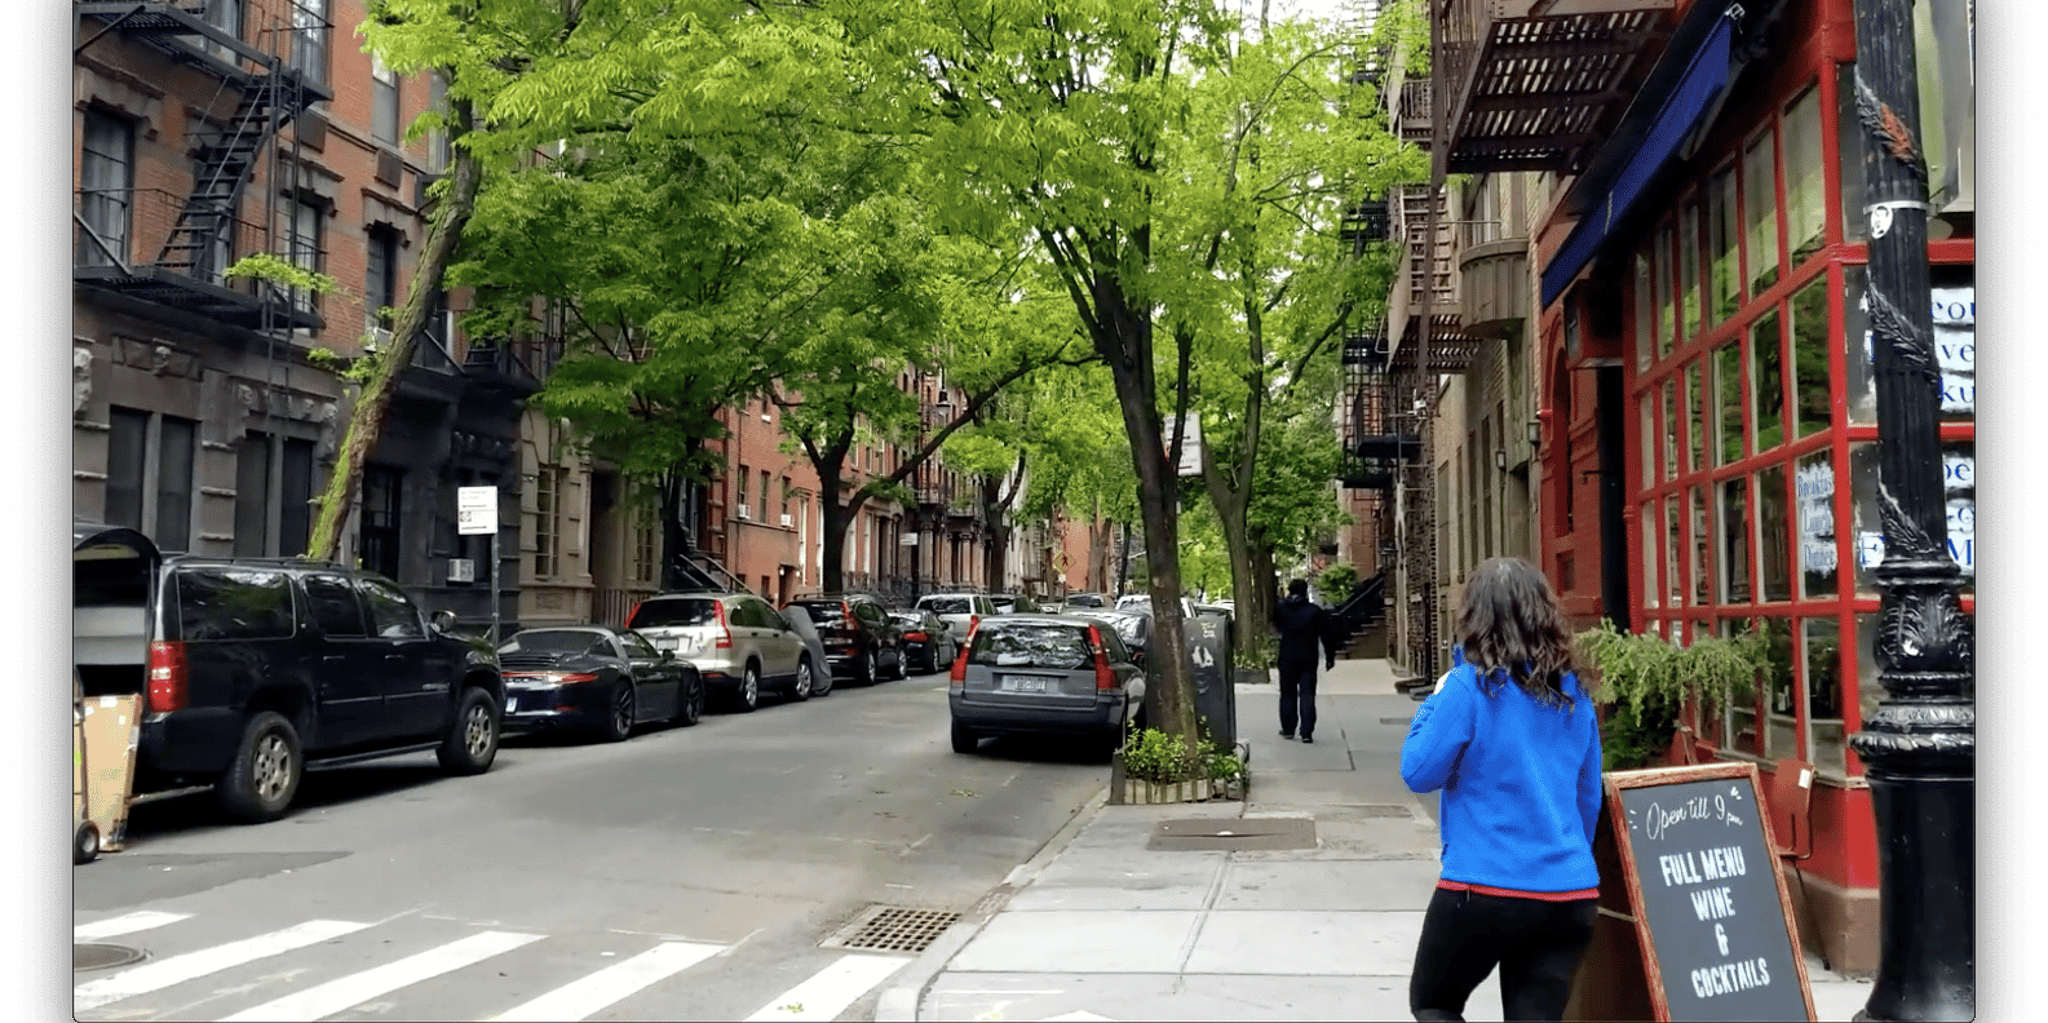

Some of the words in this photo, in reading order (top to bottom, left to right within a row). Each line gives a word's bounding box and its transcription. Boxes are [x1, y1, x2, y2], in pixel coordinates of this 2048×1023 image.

[1646, 802, 1687, 840] Open
[1687, 797, 1711, 819] till
[1715, 794, 1725, 821] 9
[1659, 852, 1703, 887] FULL
[1699, 846, 1746, 881] MENU
[1690, 886, 1736, 921] WINE
[1714, 922, 1729, 957] &
[1691, 957, 1770, 998] COCKTAILS
